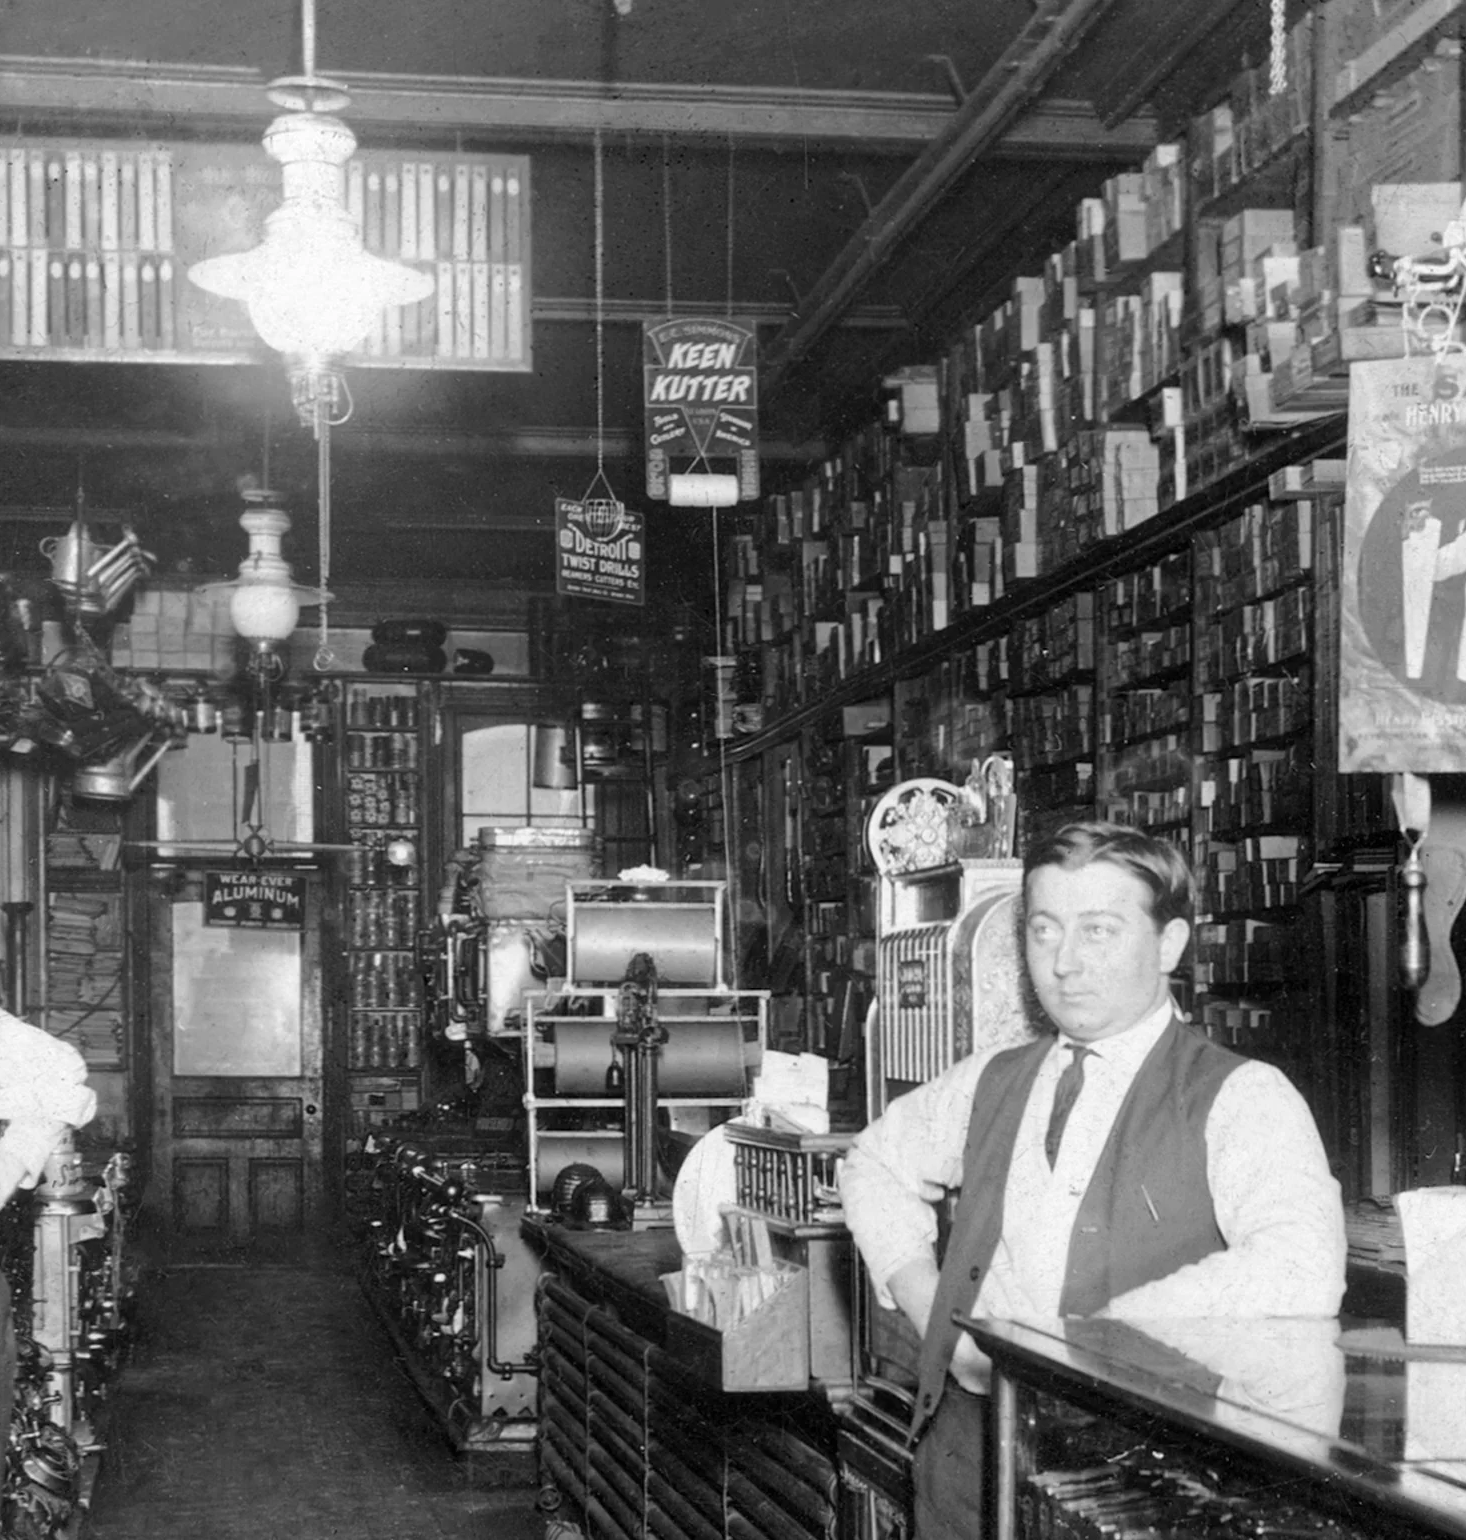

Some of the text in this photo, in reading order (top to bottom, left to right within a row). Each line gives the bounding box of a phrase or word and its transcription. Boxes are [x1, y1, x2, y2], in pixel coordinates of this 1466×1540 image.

[667, 341, 737, 370] KEEN
[650, 374, 752, 402] KUTTER
[1392, 383, 1420, 398] THE
[1405, 401, 1461, 427] HENRY
[567, 522, 634, 560] DETROIT
[561, 552, 640, 578] TWIST DRILLS
[212, 886, 300, 909] ALUMINUM
